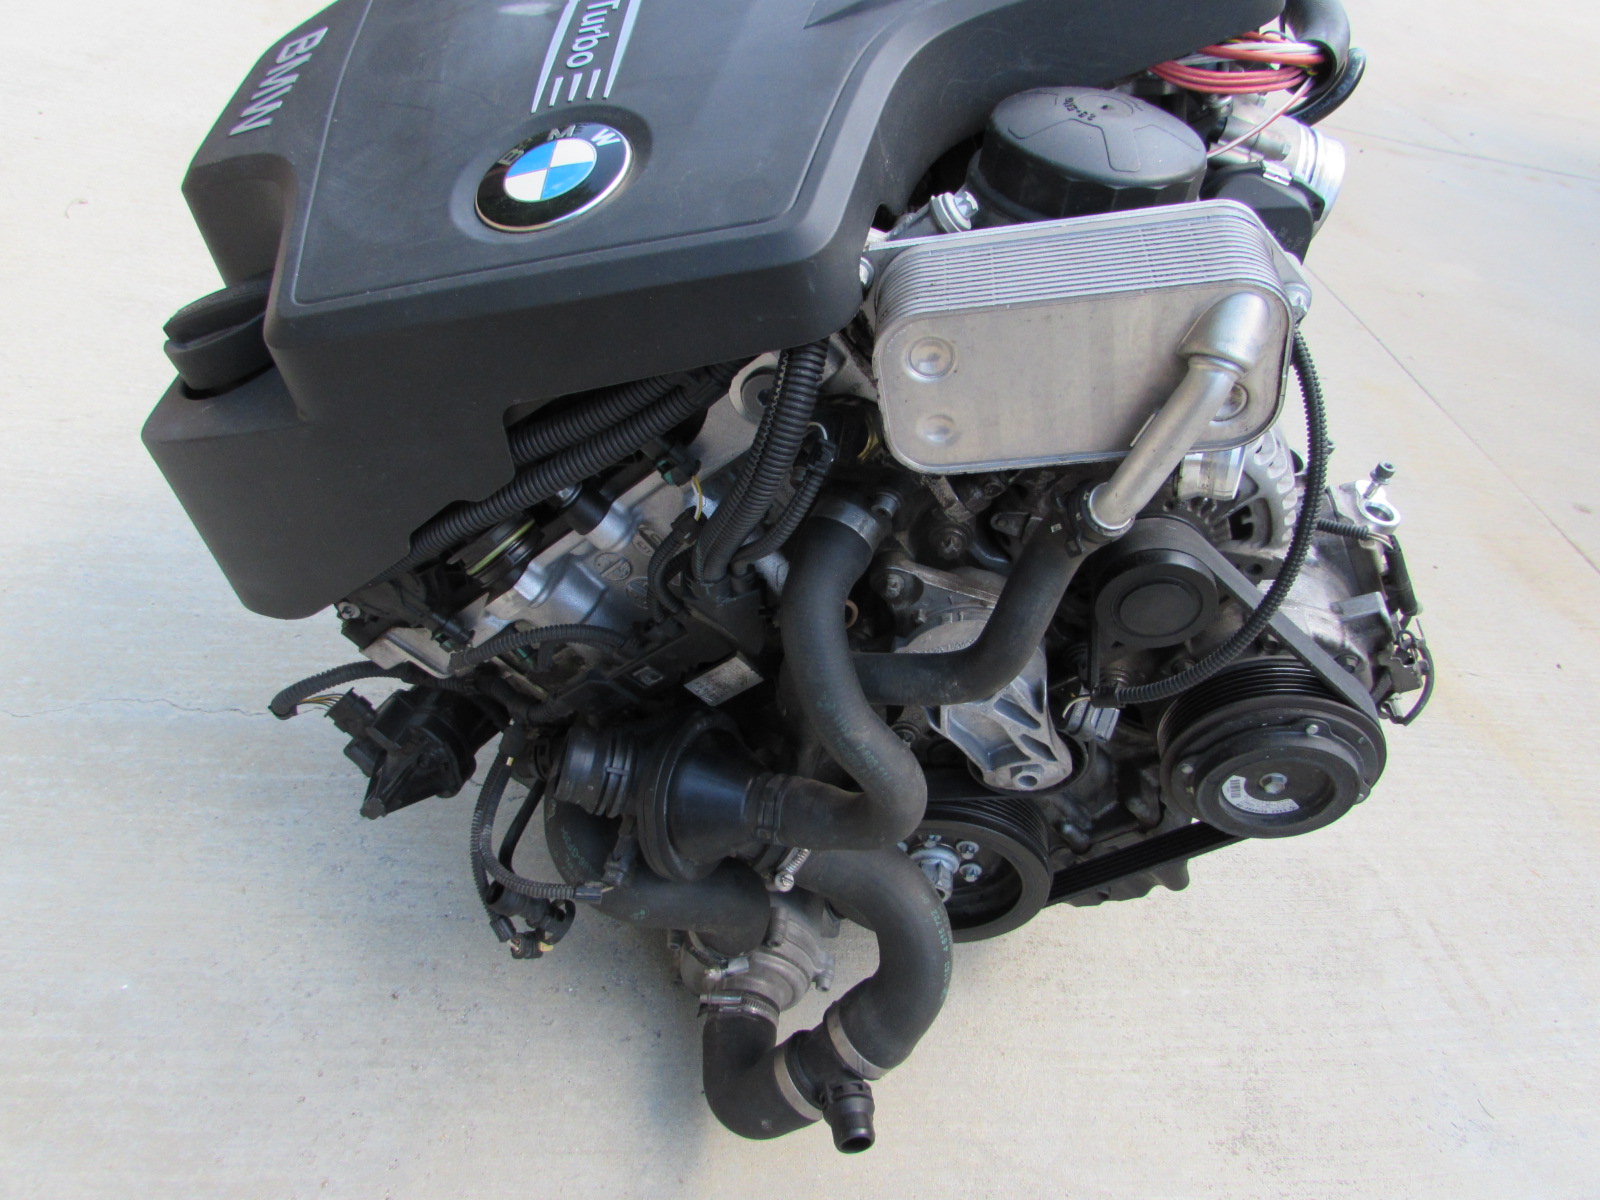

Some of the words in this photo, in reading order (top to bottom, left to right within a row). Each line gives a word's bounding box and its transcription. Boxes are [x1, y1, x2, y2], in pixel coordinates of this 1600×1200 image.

[566, 0, 620, 68] Turbo
[228, 26, 328, 136] BMW
[499, 124, 621, 166] BMW
